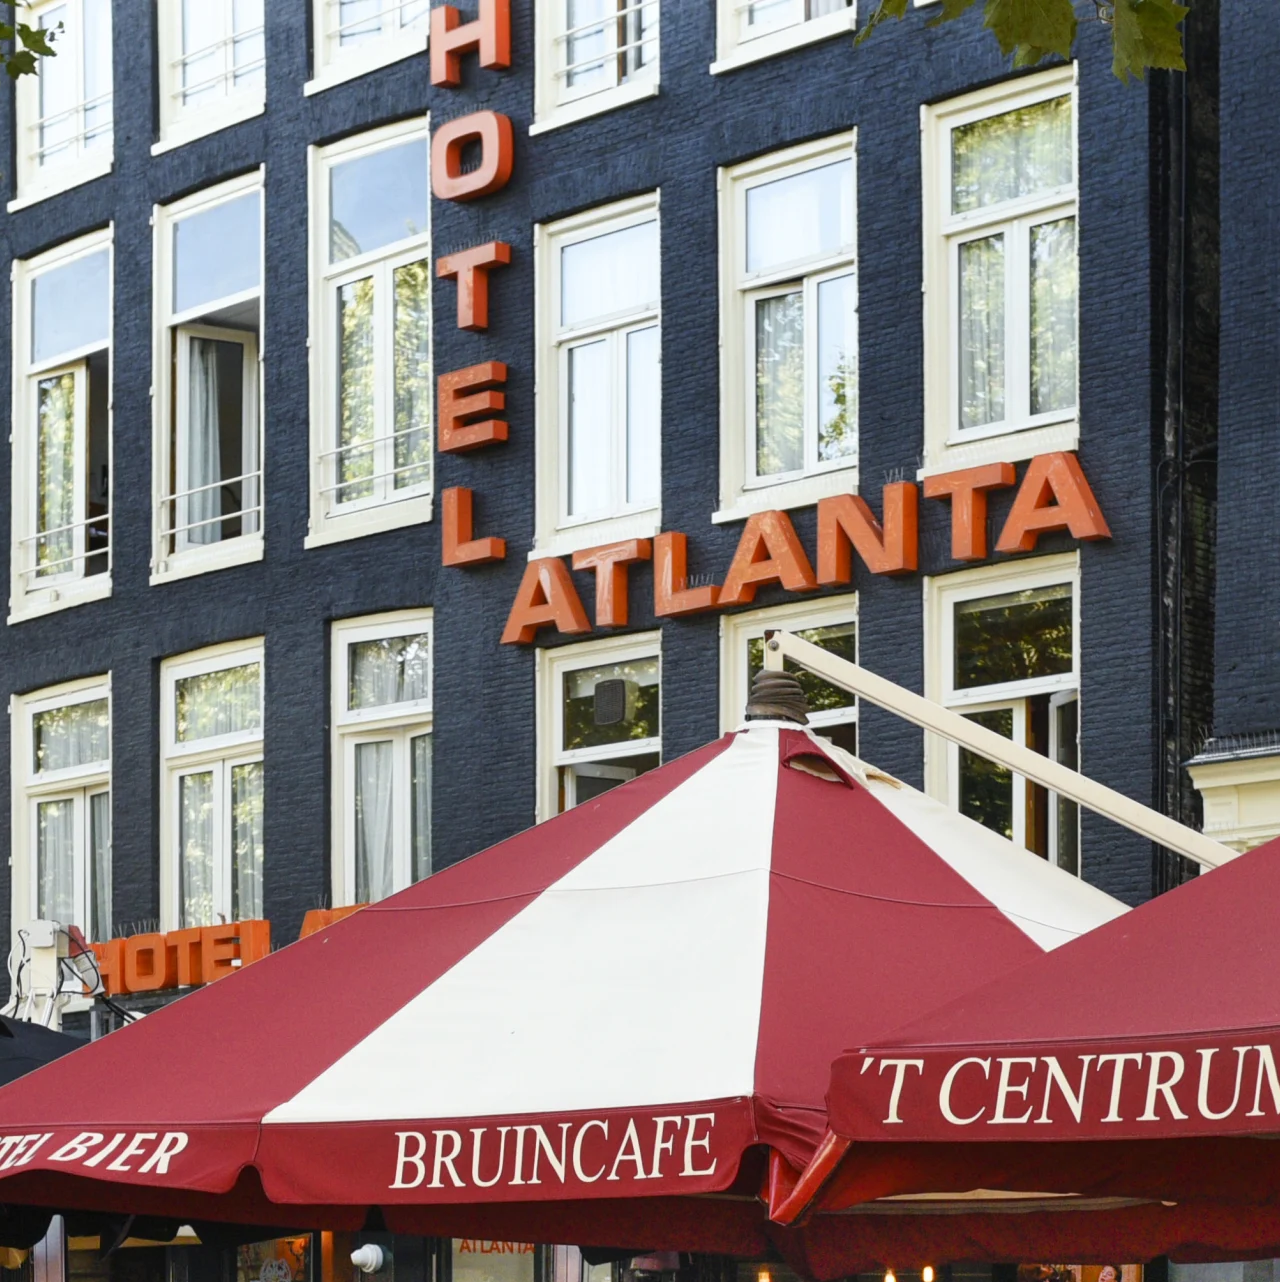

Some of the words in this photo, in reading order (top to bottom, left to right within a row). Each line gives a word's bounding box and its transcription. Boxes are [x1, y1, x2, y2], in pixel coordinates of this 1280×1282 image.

[430, 0, 513, 568] HOTEL
[499, 451, 1112, 645] ATLANTA
[47, 1132, 189, 1175] BIER
[388, 1112, 717, 1190] BRUINCAFE
